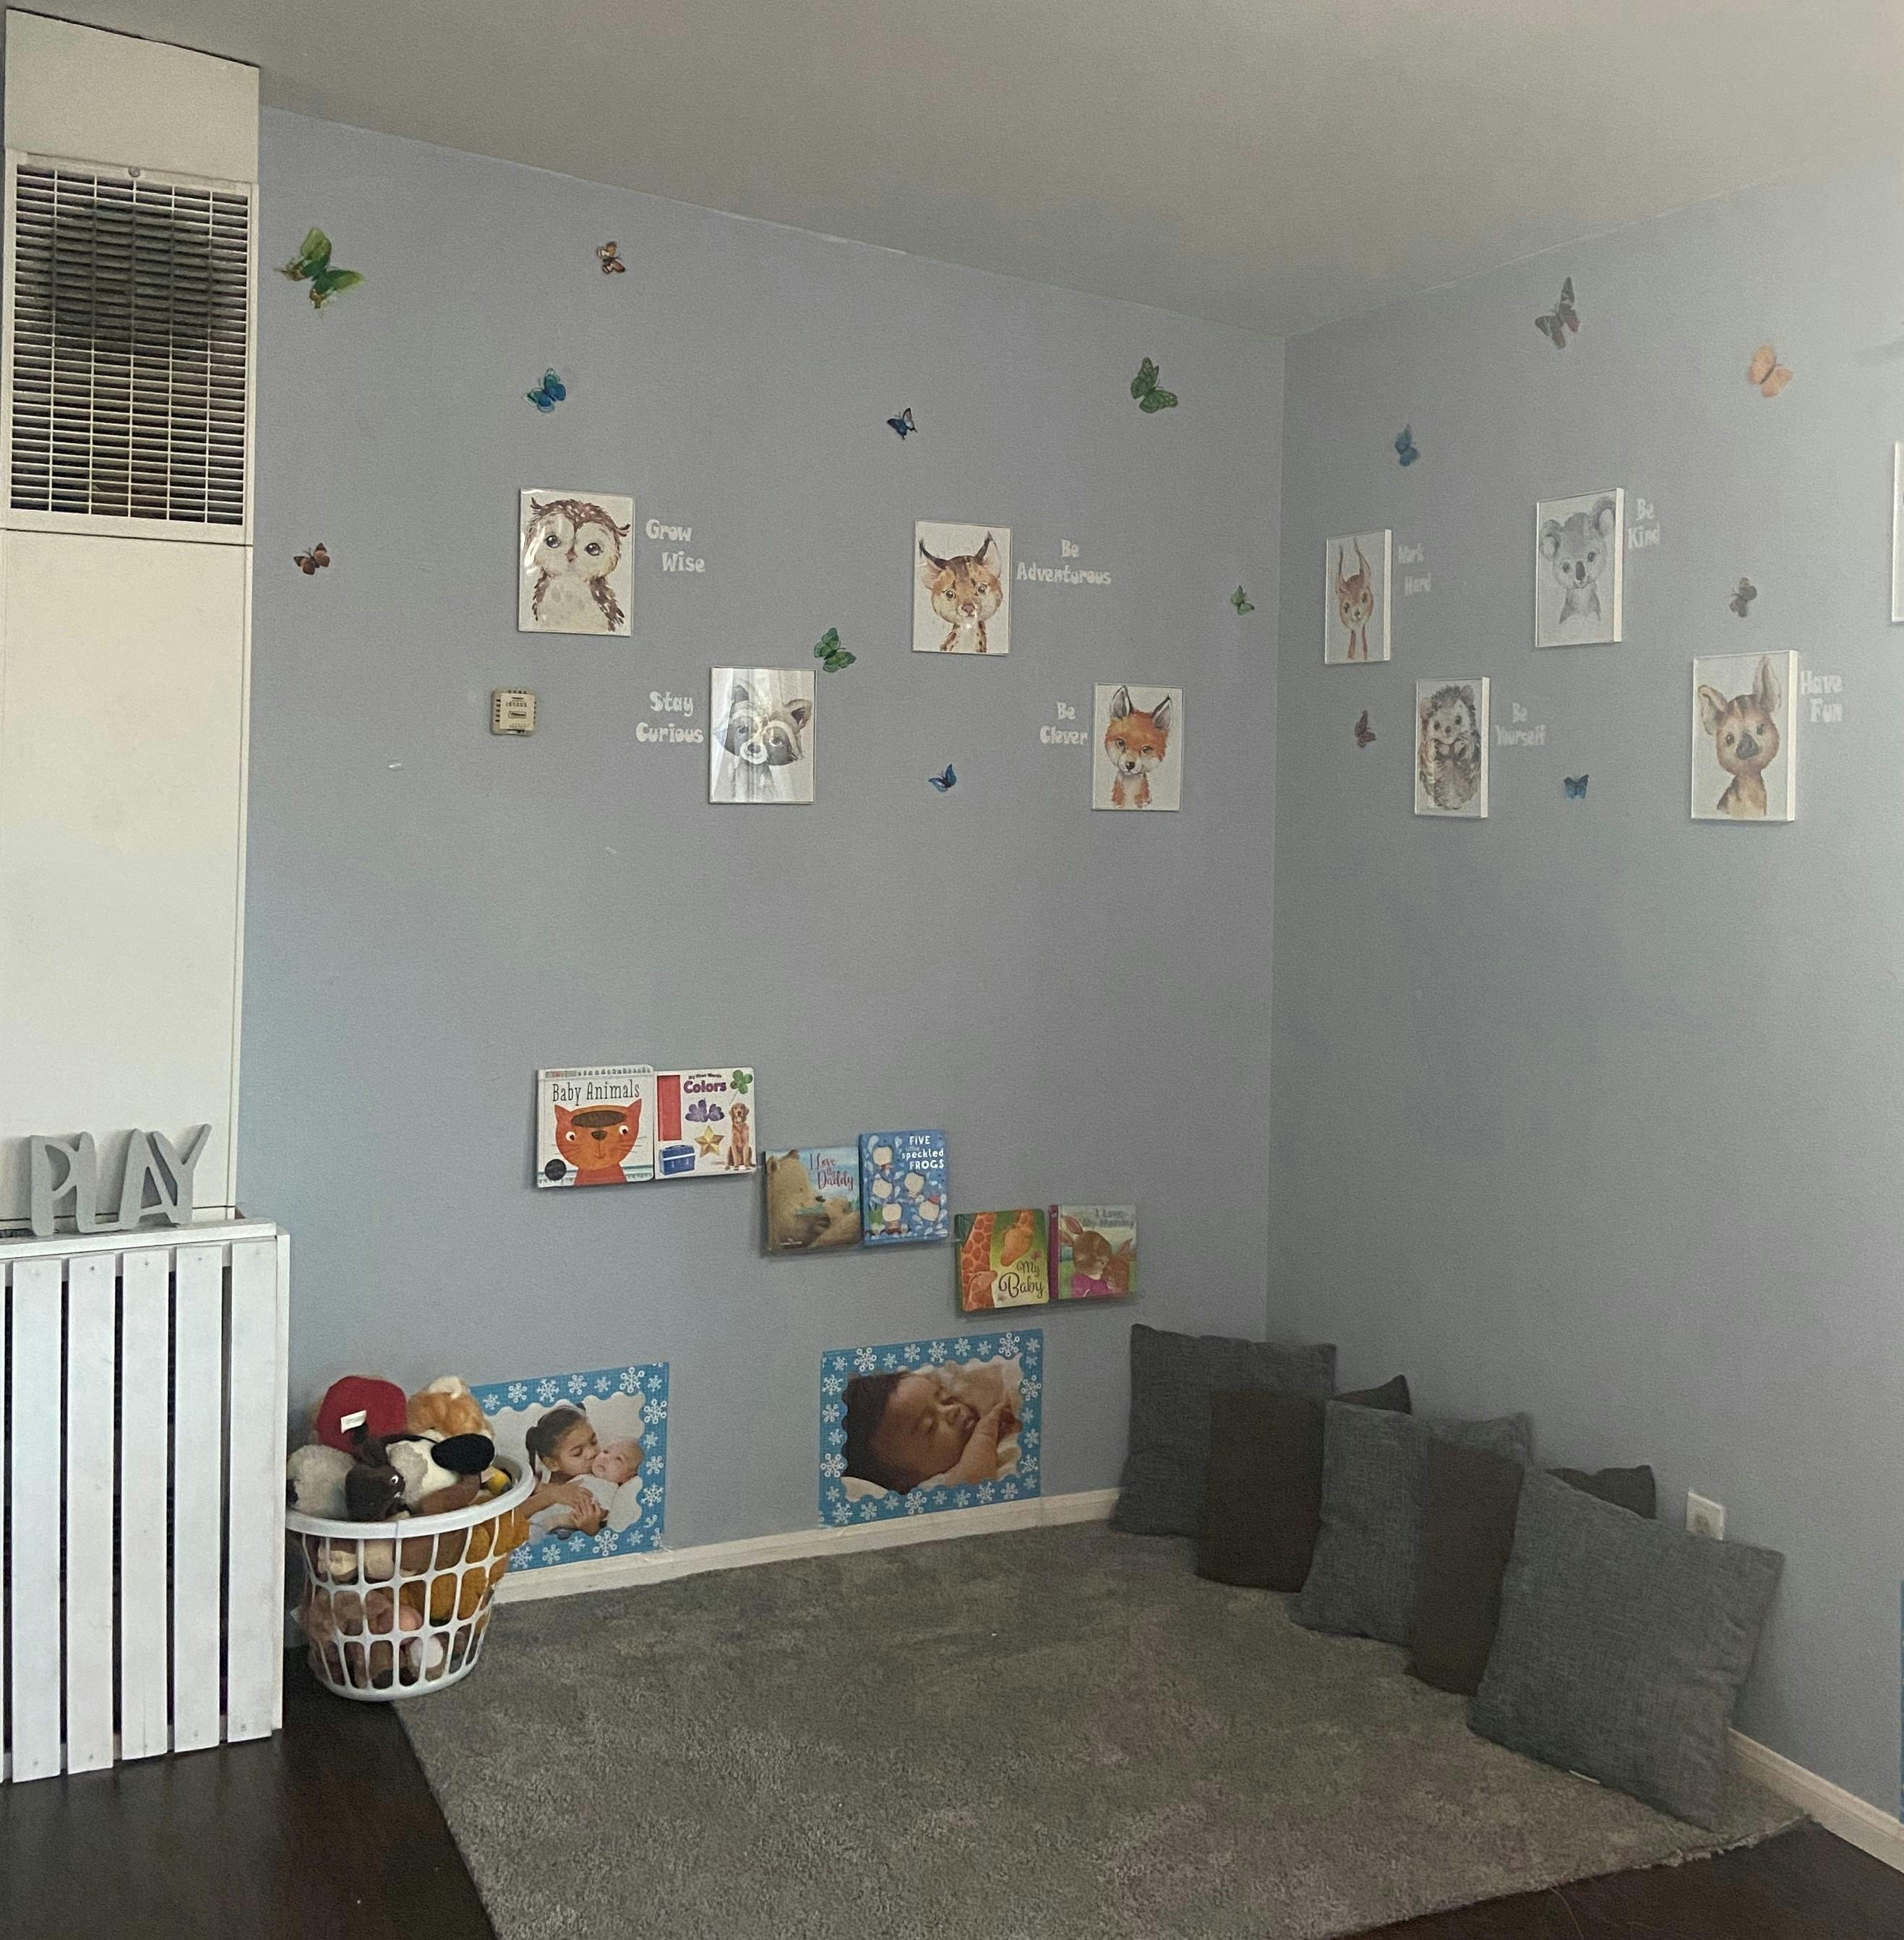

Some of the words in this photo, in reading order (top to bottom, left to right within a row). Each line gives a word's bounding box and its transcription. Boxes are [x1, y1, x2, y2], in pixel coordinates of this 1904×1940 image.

[1636, 498, 1654, 520] Be
[646, 519, 692, 541] Grow
[1628, 522, 1660, 549] Kind
[1061, 539, 1079, 557] Be
[662, 551, 705, 572] Wise
[1016, 562, 1111, 584] Adventurous
[1800, 671, 1842, 695] Have
[650, 691, 693, 716] Stay
[1057, 702, 1076, 719] Be
[1512, 703, 1527, 722] Be
[1810, 698, 1842, 722] Fun
[636, 722, 703, 743] Curious
[1040, 726, 1088, 744] Clever
[1494, 724, 1545, 746] Yourself
[552, 1082, 581, 1106] Baby
[586, 1079, 640, 1099] Animals
[683, 1080, 726, 1094] Colors
[909, 1136, 930, 1145] FIVE
[901, 1148, 943, 1161] speckled
[909, 1159, 944, 1169] FROGS
[31, 1124, 212, 1236] PLAY
[818, 1170, 854, 1191] Daddy
[1017, 1261, 1039, 1277] My
[999, 1272, 1043, 1299] Baby
